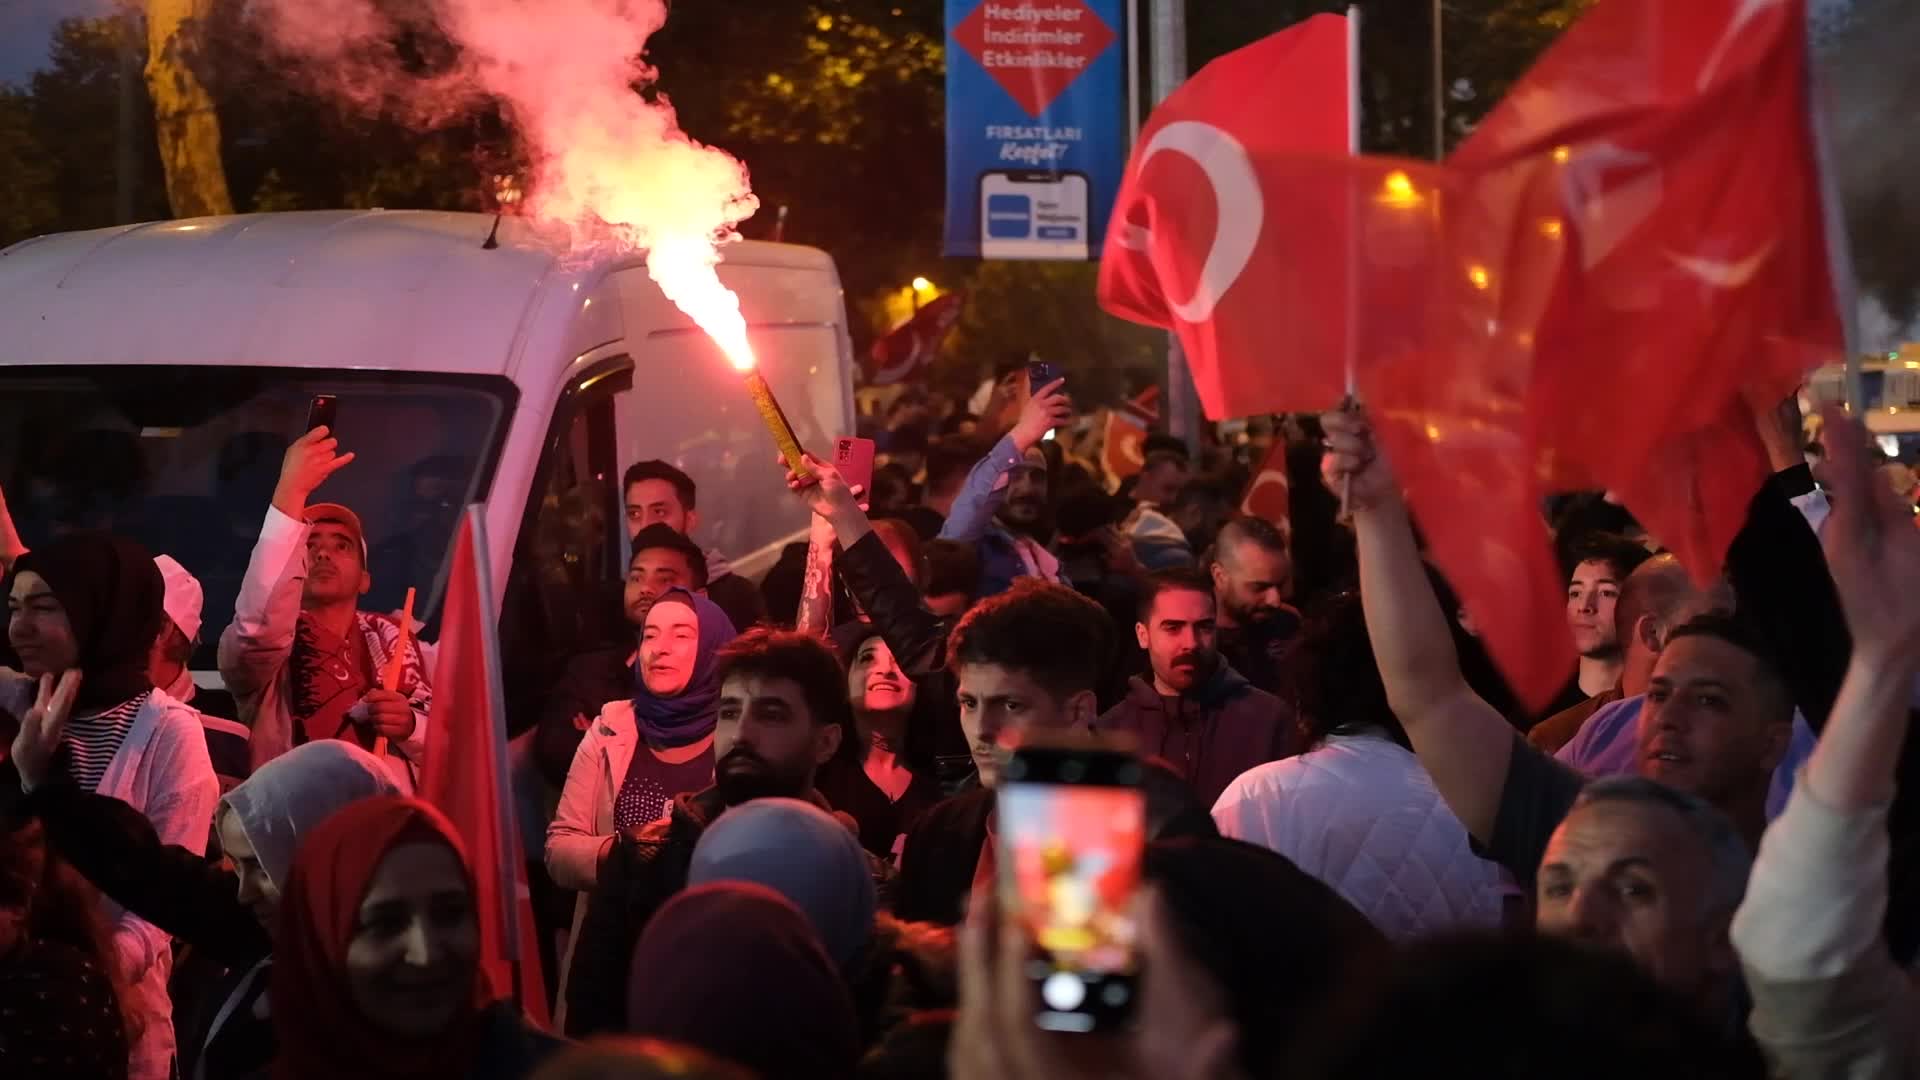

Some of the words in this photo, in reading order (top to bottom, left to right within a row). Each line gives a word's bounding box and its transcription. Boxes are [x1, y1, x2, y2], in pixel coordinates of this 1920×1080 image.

[983, 3, 1083, 24] Hediyeler
[983, 21, 1083, 45] İndirimler
[982, 50, 1087, 69] Etkinlikler
[985, 125, 1083, 141] FIRSATLARI
